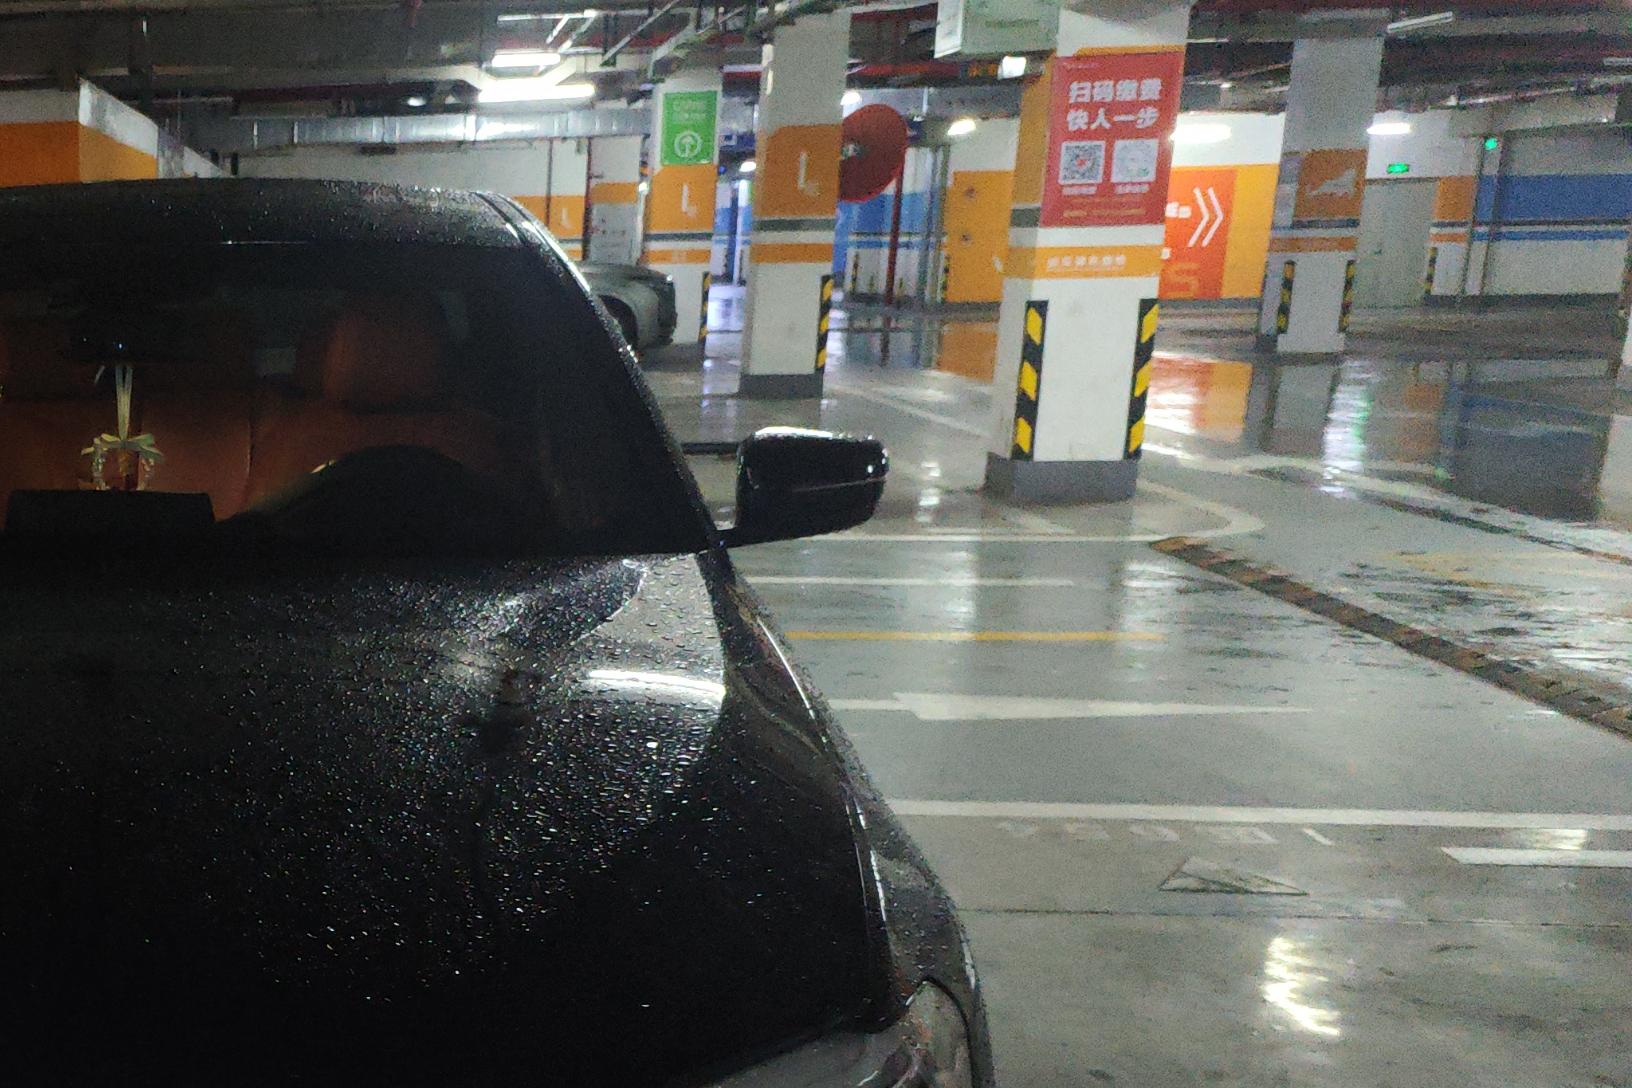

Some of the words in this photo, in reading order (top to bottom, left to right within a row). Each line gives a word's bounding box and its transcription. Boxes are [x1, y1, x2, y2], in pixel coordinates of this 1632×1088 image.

[1068, 77, 1163, 104] 扫码缴费
[1066, 106, 1159, 131] 快人一步
